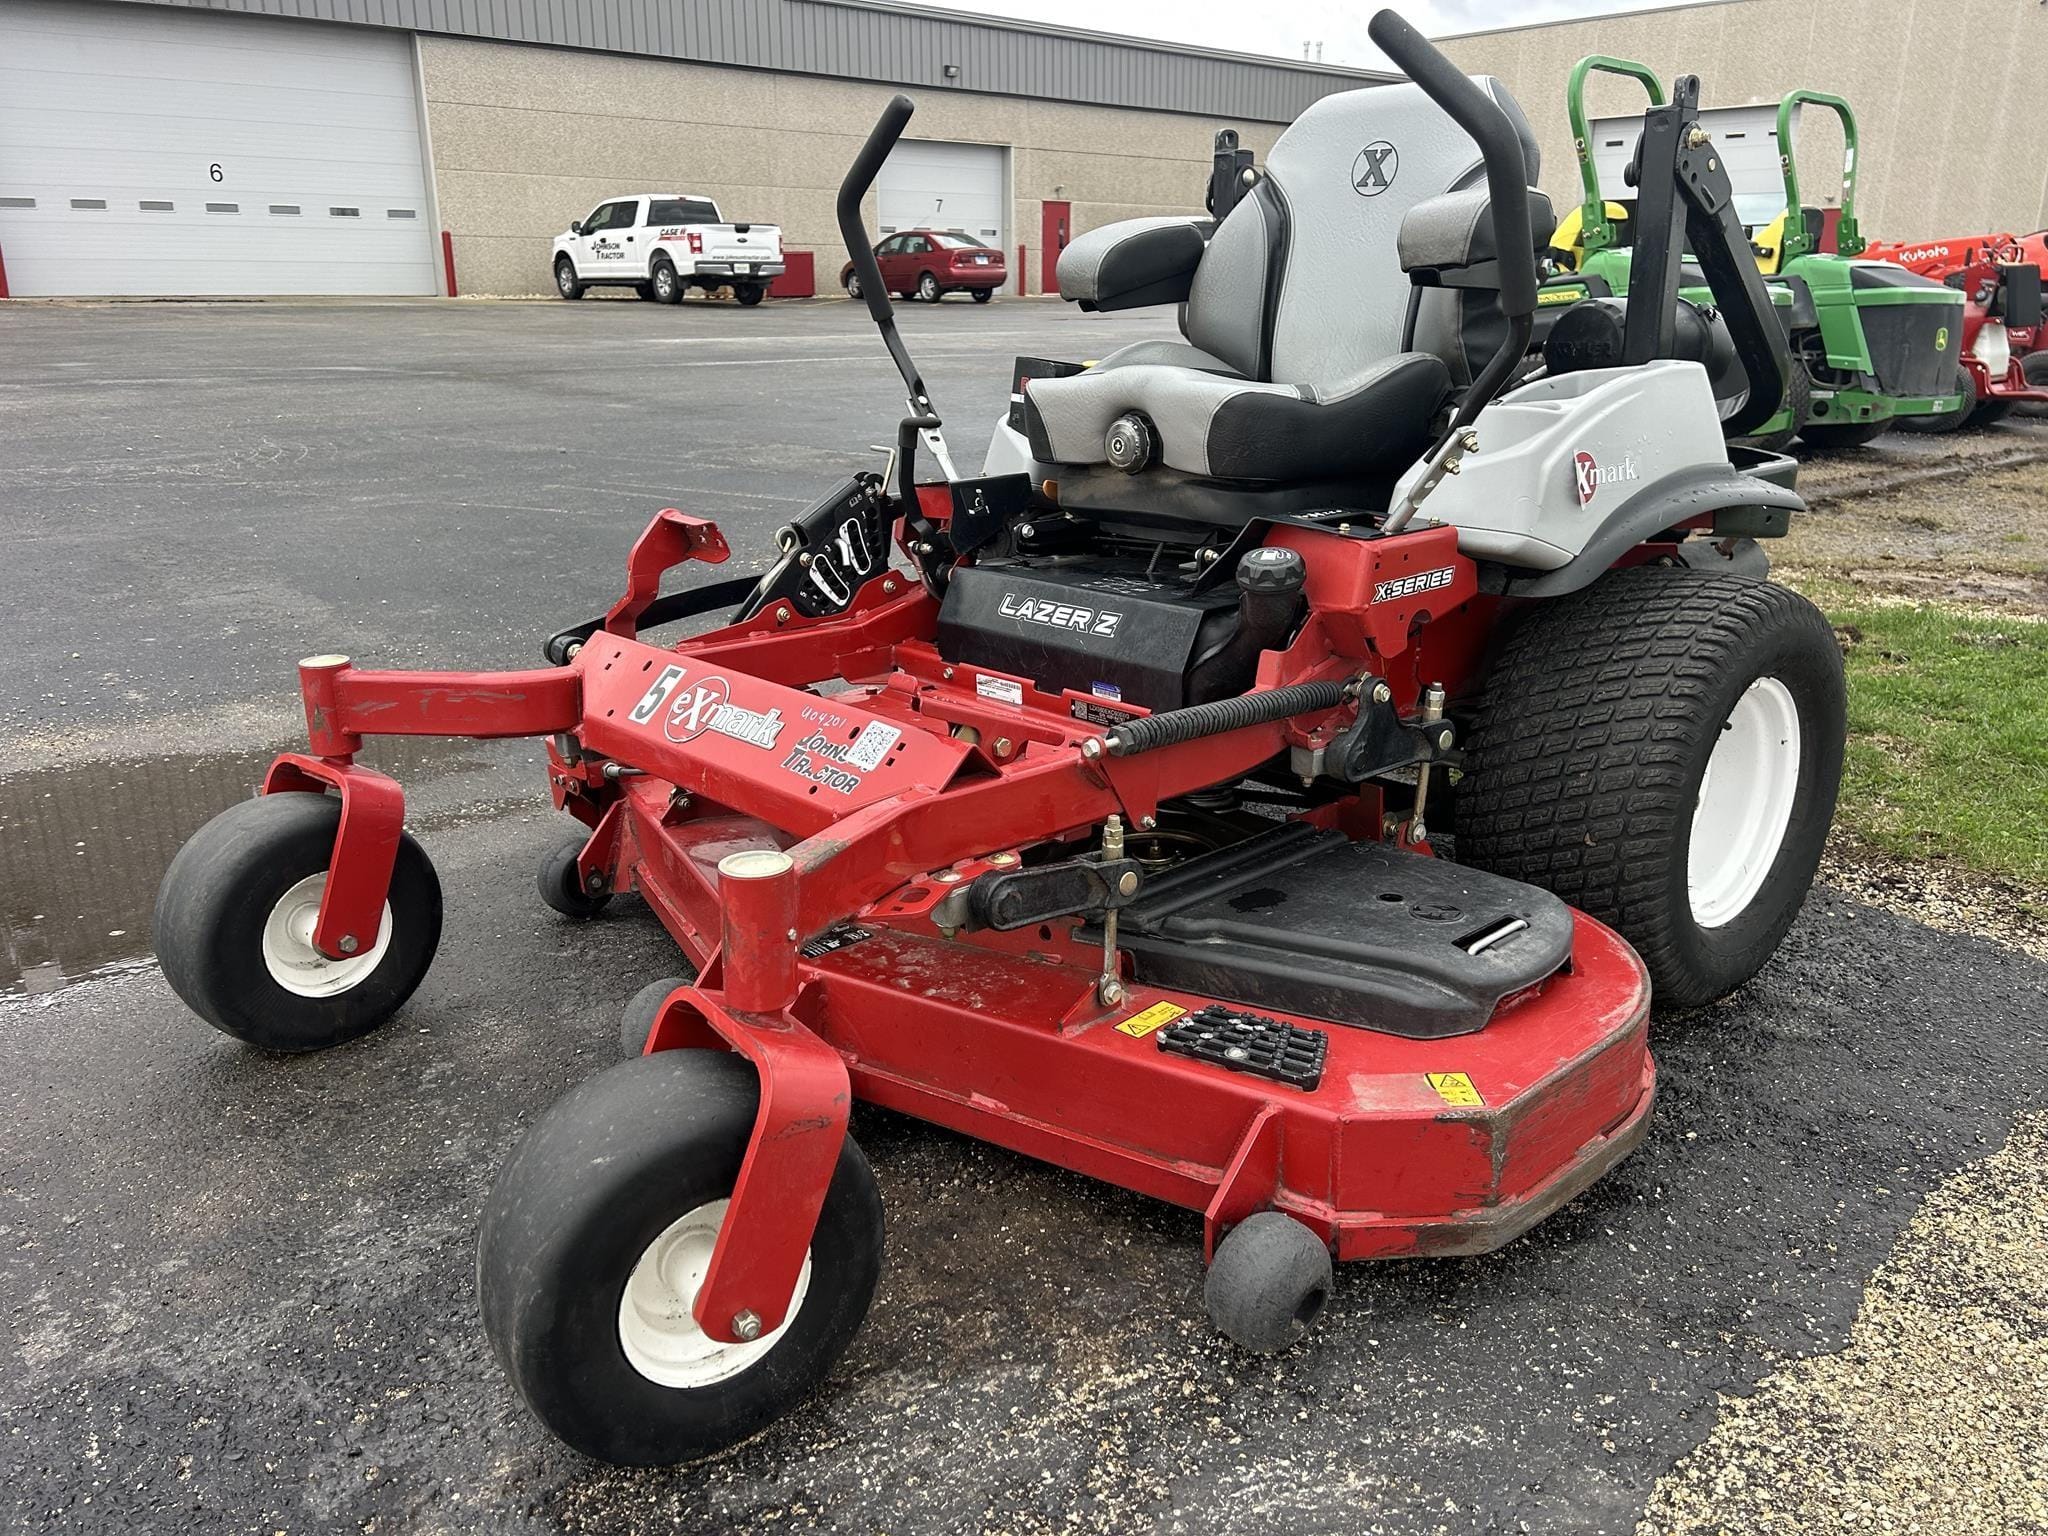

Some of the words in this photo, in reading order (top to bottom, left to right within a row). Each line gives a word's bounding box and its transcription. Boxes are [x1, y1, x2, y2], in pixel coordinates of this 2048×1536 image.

[210, 163, 224, 183] 6
[936, 199, 944, 214] 7
[660, 228, 680, 236] CASE
[590, 240, 621, 251] JOHNSON
[596, 250, 625, 260] TRACTOR
[1898, 246, 1949, 263] Kubota
[999, 594, 1094, 633] LAZER
[1092, 612, 1121, 637] Z
[635, 667, 682, 720] 5
[782, 747, 860, 793] TRACTOR
